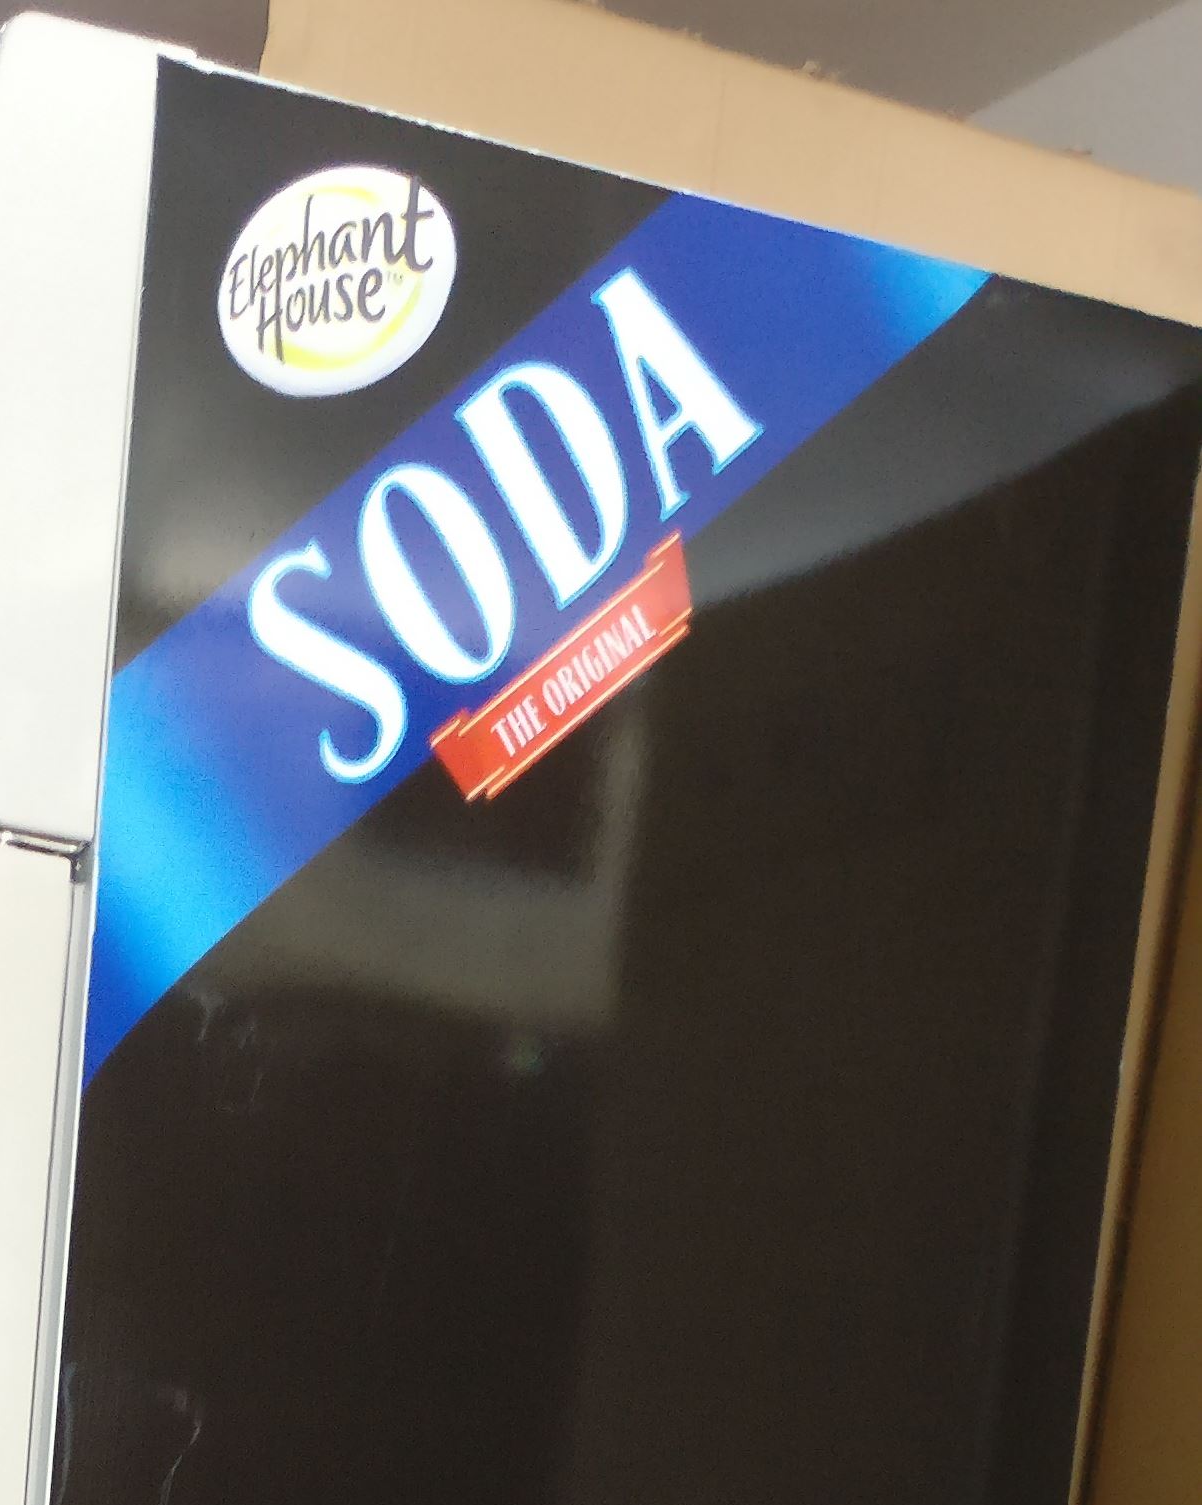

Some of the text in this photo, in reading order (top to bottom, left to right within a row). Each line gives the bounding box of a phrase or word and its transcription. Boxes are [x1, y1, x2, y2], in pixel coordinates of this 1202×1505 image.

[228, 176, 435, 320] Elephant
[256, 267, 386, 364] House
[246, 266, 764, 785] SODA
[490, 604, 657, 758] THE ORIGINAL
